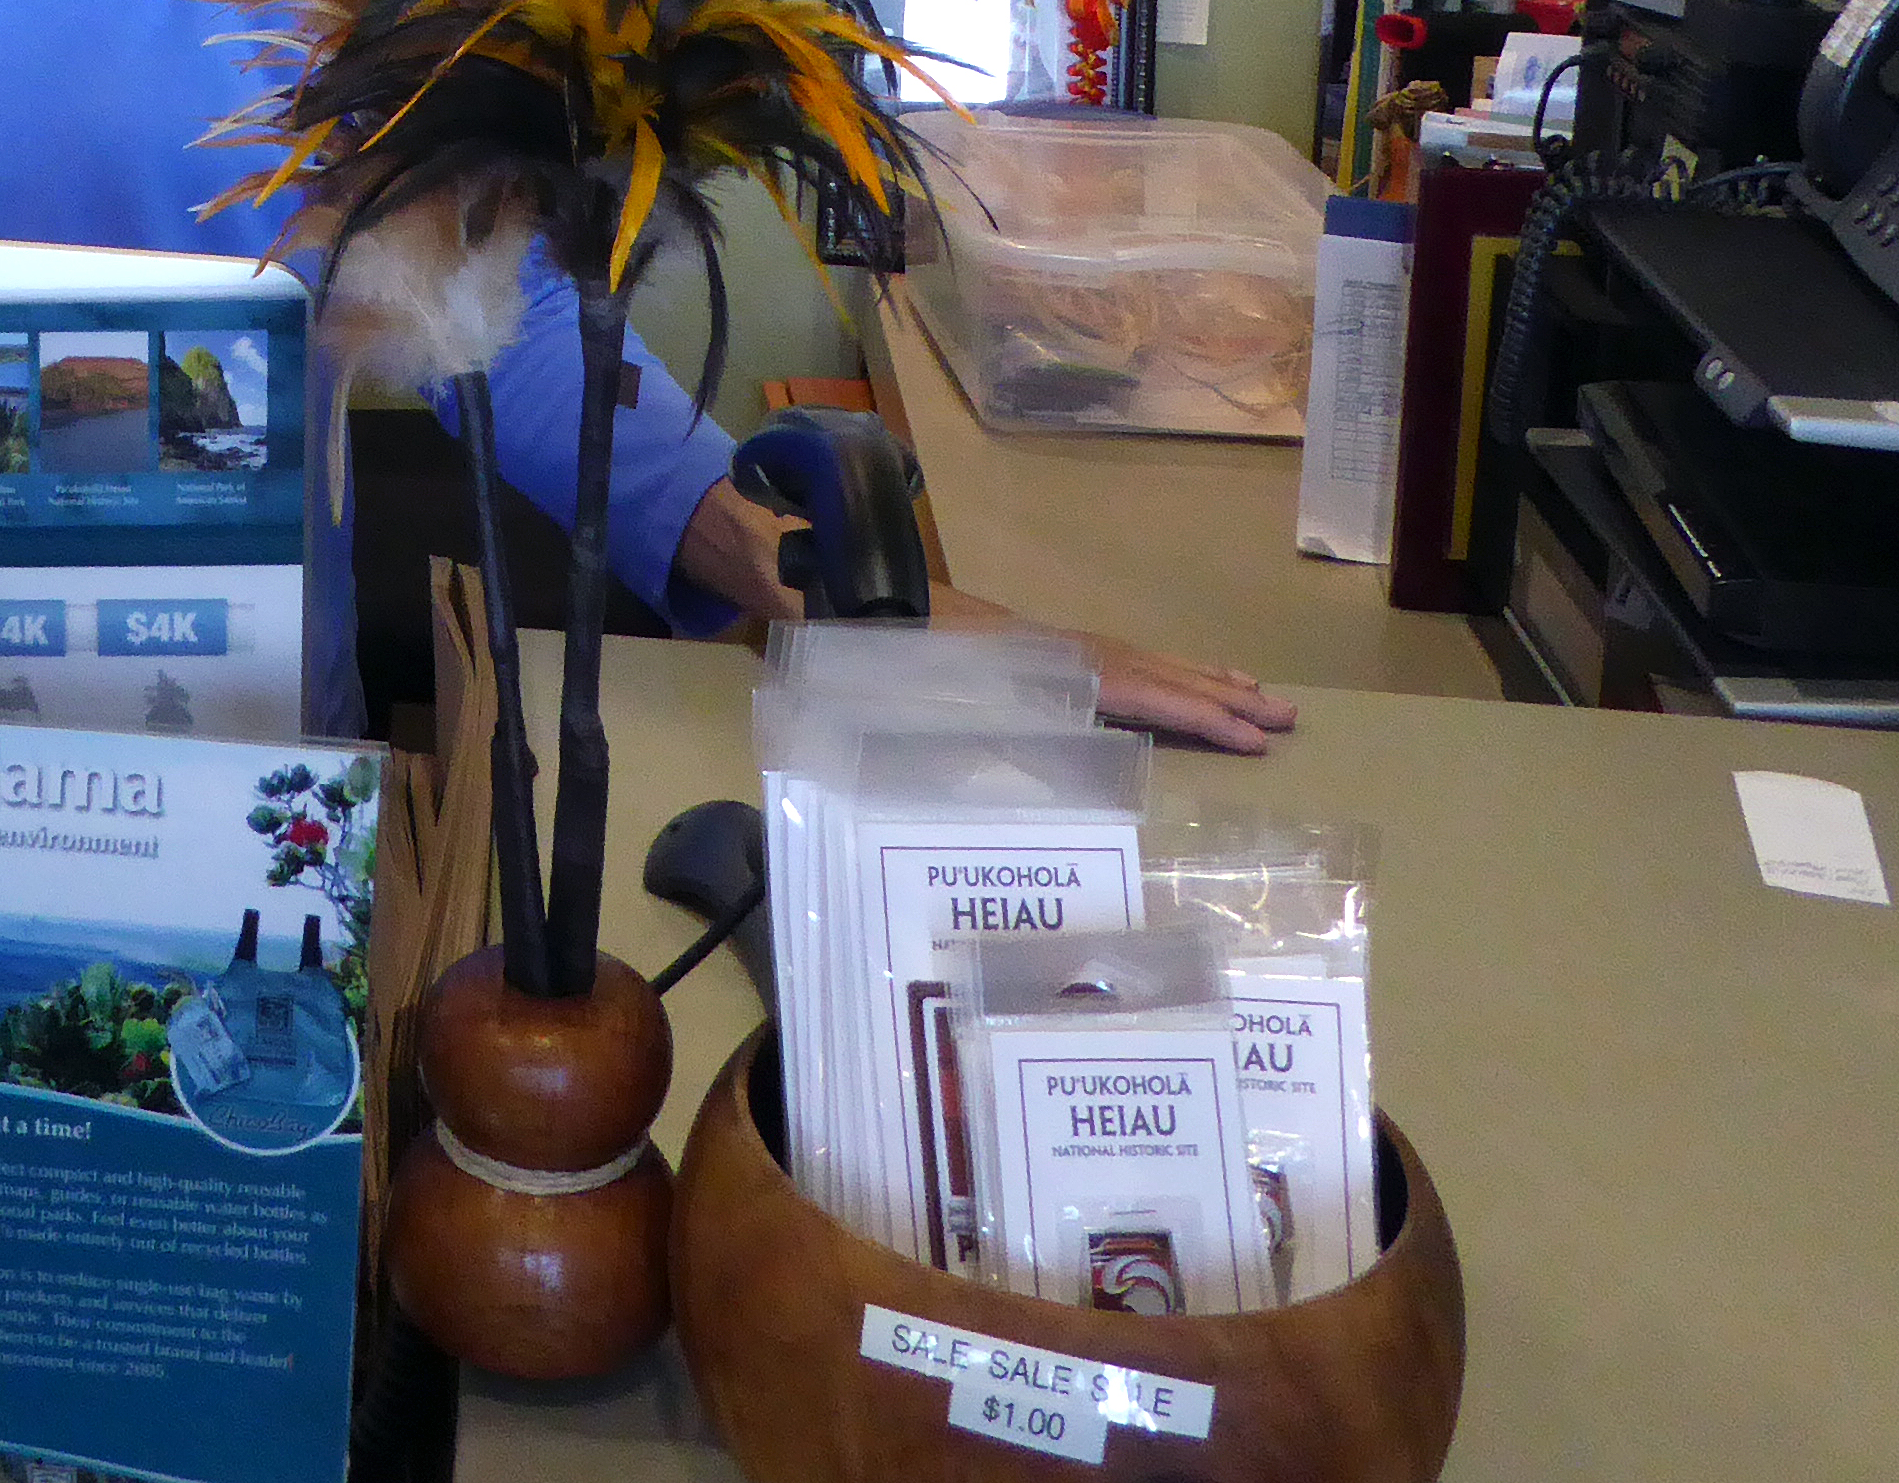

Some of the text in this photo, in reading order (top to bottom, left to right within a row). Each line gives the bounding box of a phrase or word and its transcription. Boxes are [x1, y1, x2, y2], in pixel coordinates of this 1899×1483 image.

[124, 610, 199, 645] $4K
[928, 862, 1081, 887] PU'UKOHOLĀ
[951, 897, 1063, 932] HEIAU
[1234, 1013, 1313, 1036] OHOLĀ
[1233, 1041, 1293, 1072] IAU
[1046, 1072, 1193, 1096] PU'UKOHOLĀ
[1292, 1081, 1317, 1094] SITE
[15, 1120, 27, 1135] a
[34, 1117, 91, 1142] time!
[1070, 1104, 1176, 1136] HEIAU
[1052, 1143, 1199, 1157] NATIONAL HISTORIC SITE
[892, 1324, 1174, 1418] SALE SALE SLE
[982, 1394, 1065, 1442] $1.00
